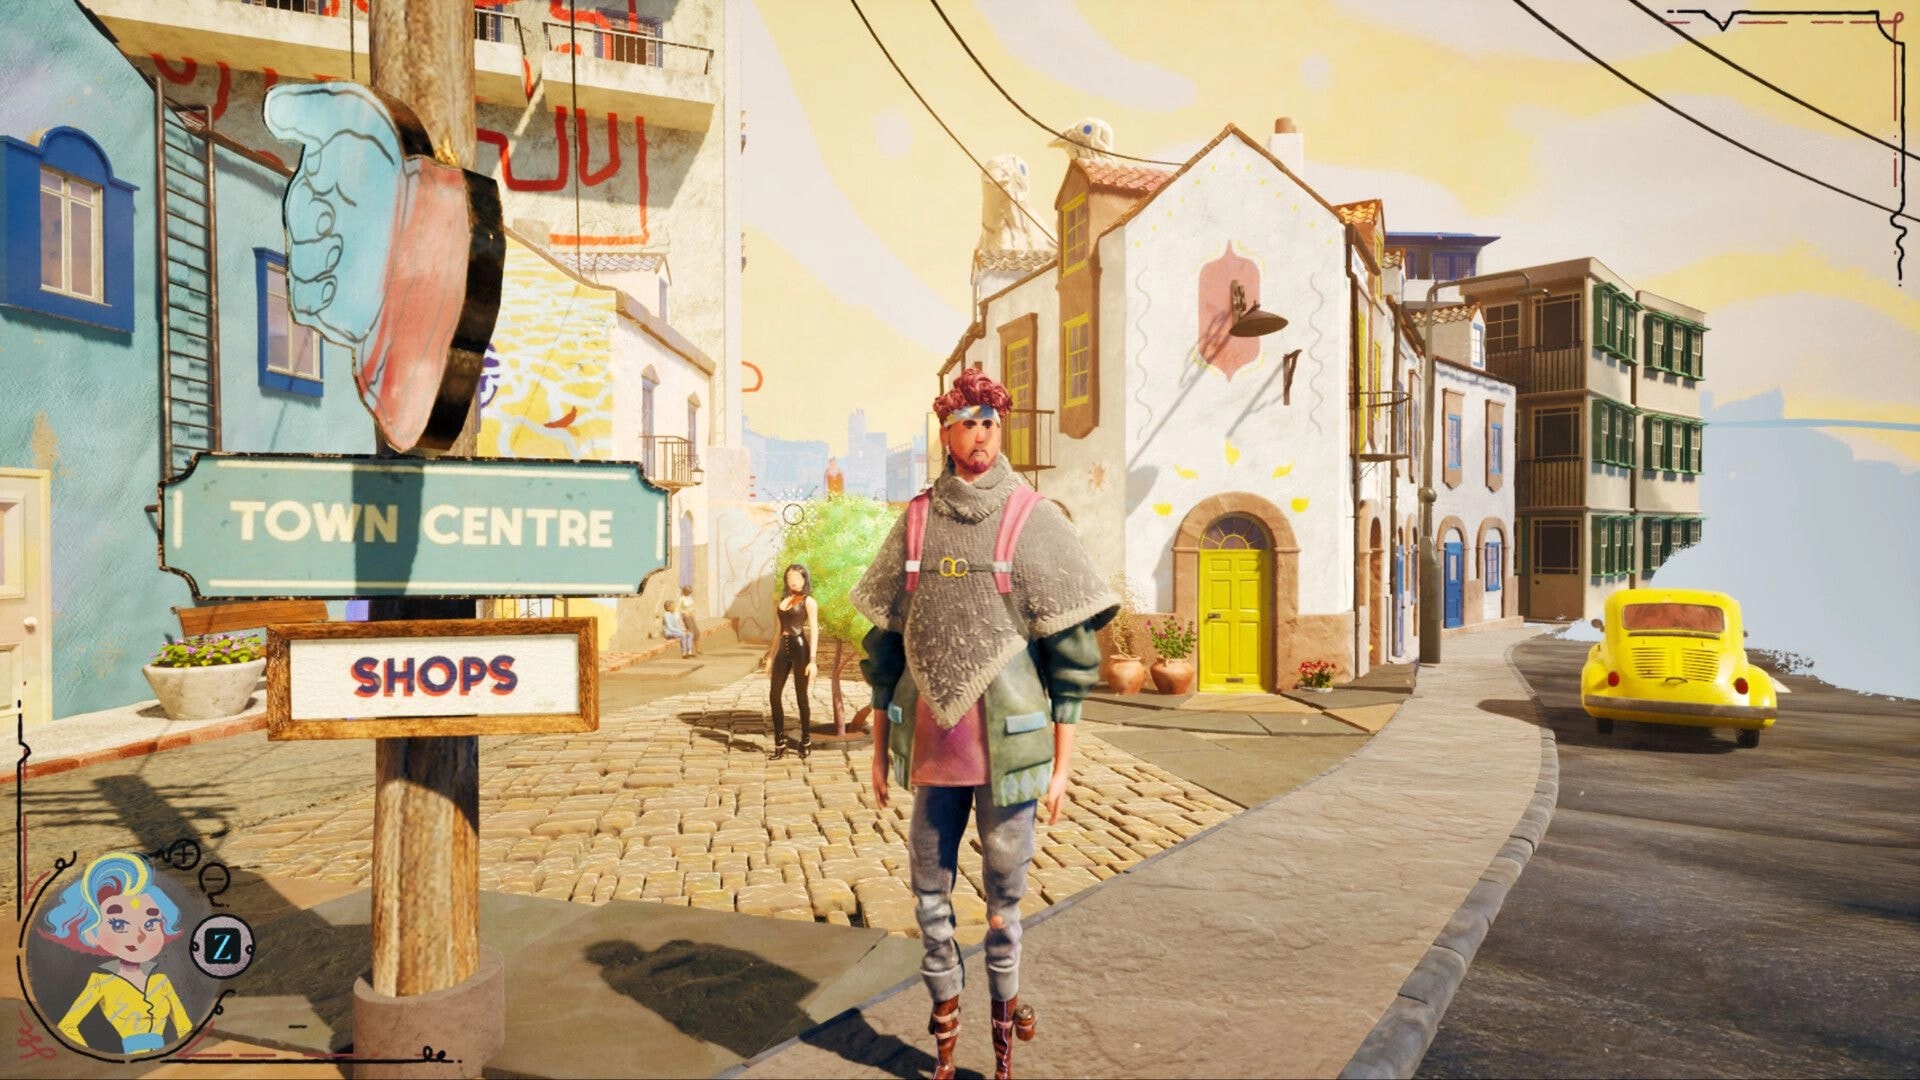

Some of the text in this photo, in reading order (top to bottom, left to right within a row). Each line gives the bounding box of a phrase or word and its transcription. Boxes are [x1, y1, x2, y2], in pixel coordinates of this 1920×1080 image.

[230, 500, 613, 548] TOWN CENTRE
[351, 655, 518, 698] SHOPS
